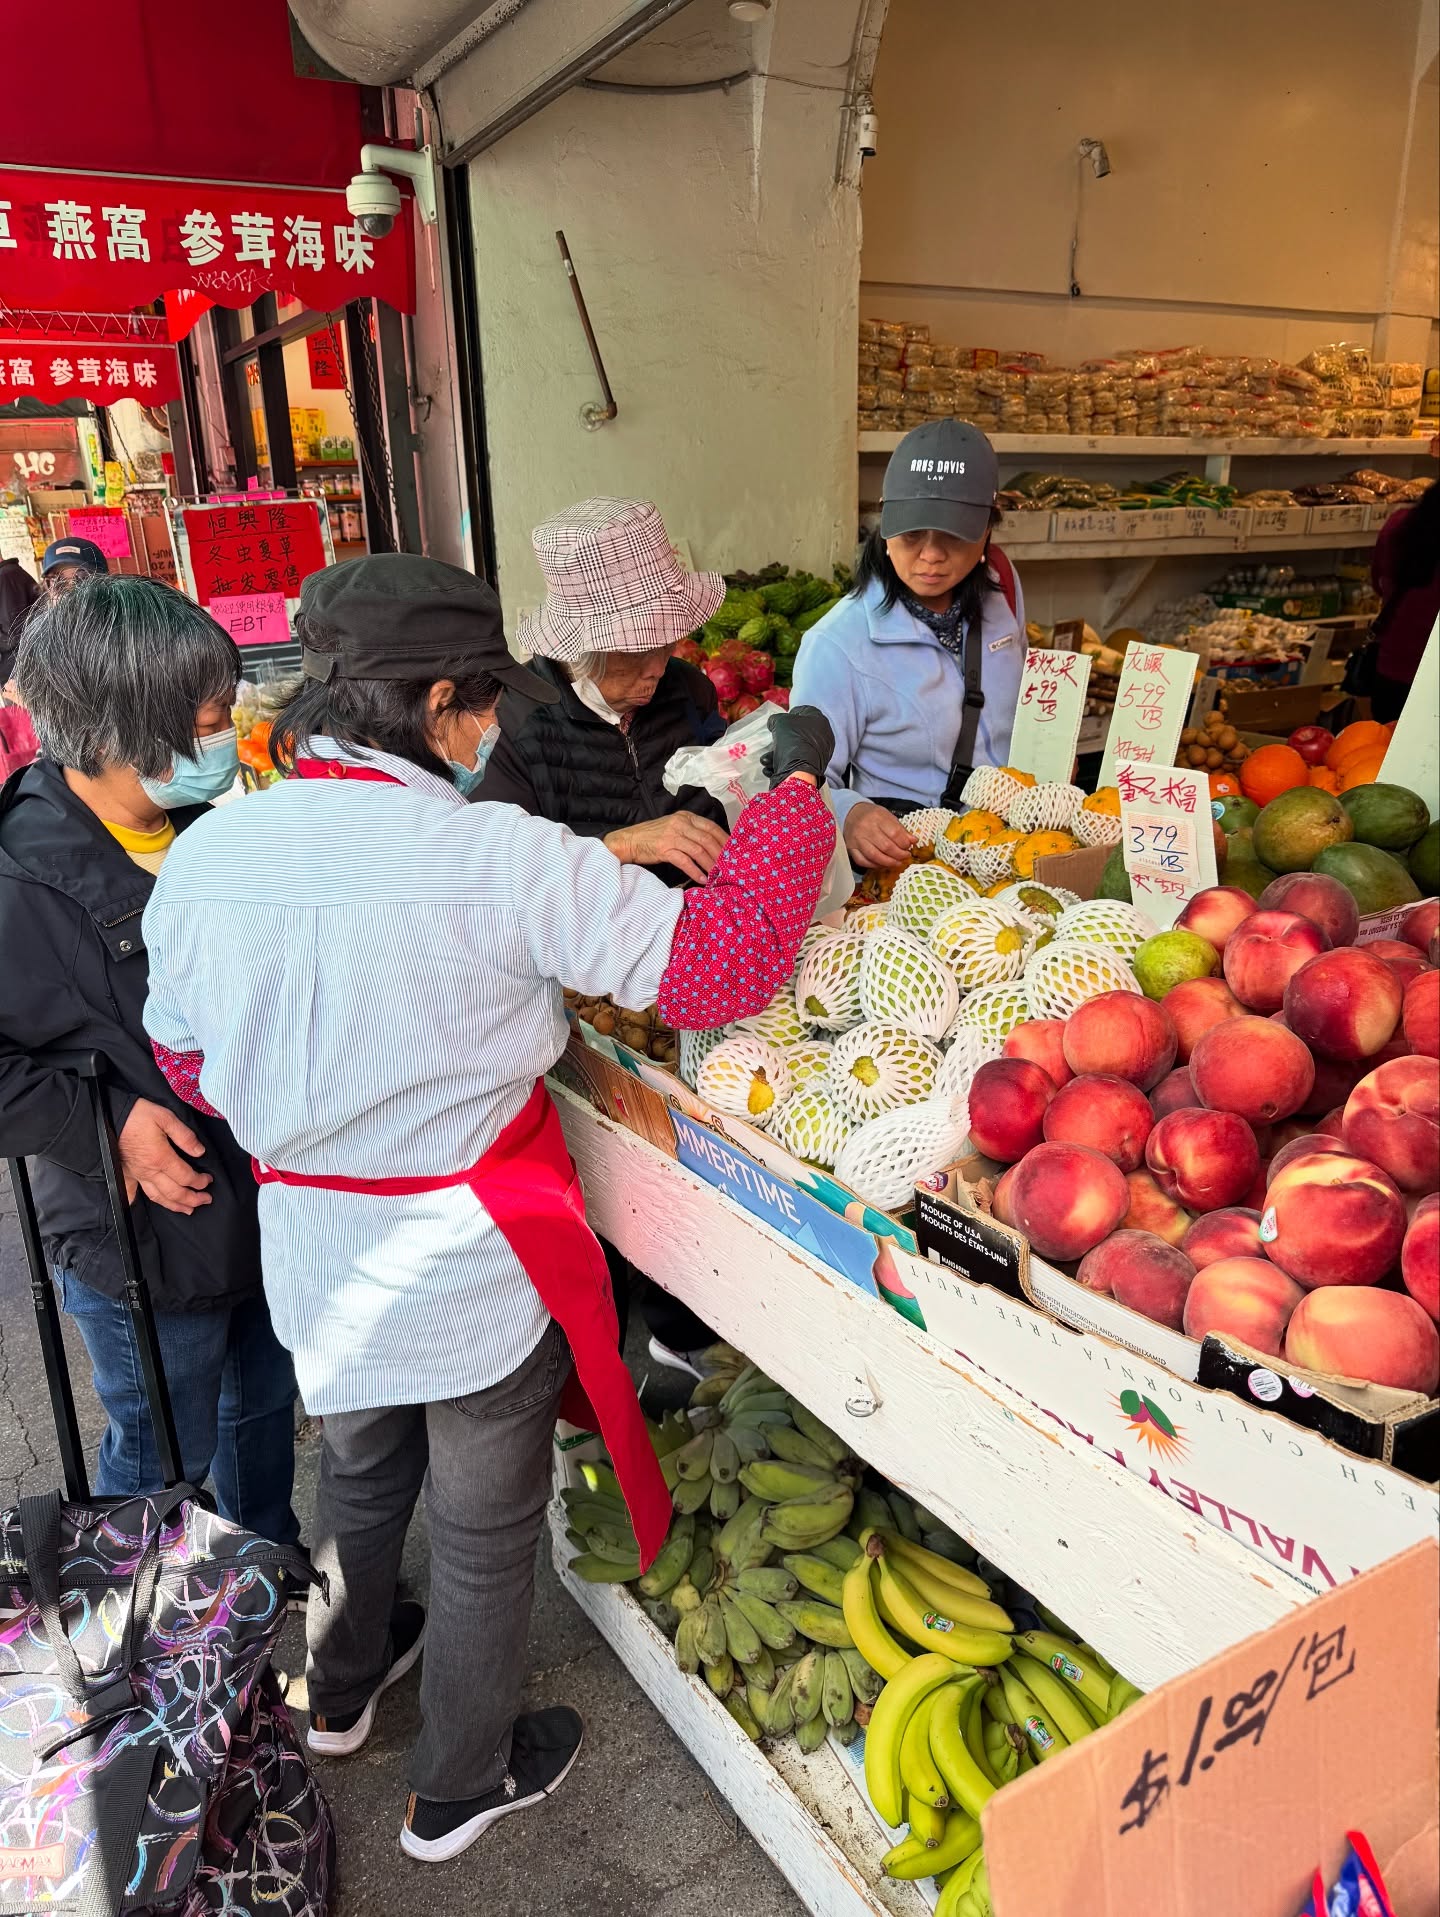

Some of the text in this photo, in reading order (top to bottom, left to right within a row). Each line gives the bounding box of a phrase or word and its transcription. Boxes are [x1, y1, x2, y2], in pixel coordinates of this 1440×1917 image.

[44, 199, 150, 263] 燕窩
[178, 208, 375, 274] 參茸海味
[50, 357, 157, 388] 參茸海味
[937, 460, 965, 474] DAVIS
[229, 616, 267, 633] EBT
[920, 1201, 952, 1224] PRODUCE
[953, 1219, 963, 1230] OF
[920, 1211, 1008, 1267] PRODUITS DES ÉTATS-UNIS
[911, 1264, 979, 1307] FRUIT
[995, 1304, 1061, 1347] TREE
[1082, 1347, 1304, 1457] CALIFORNIA
